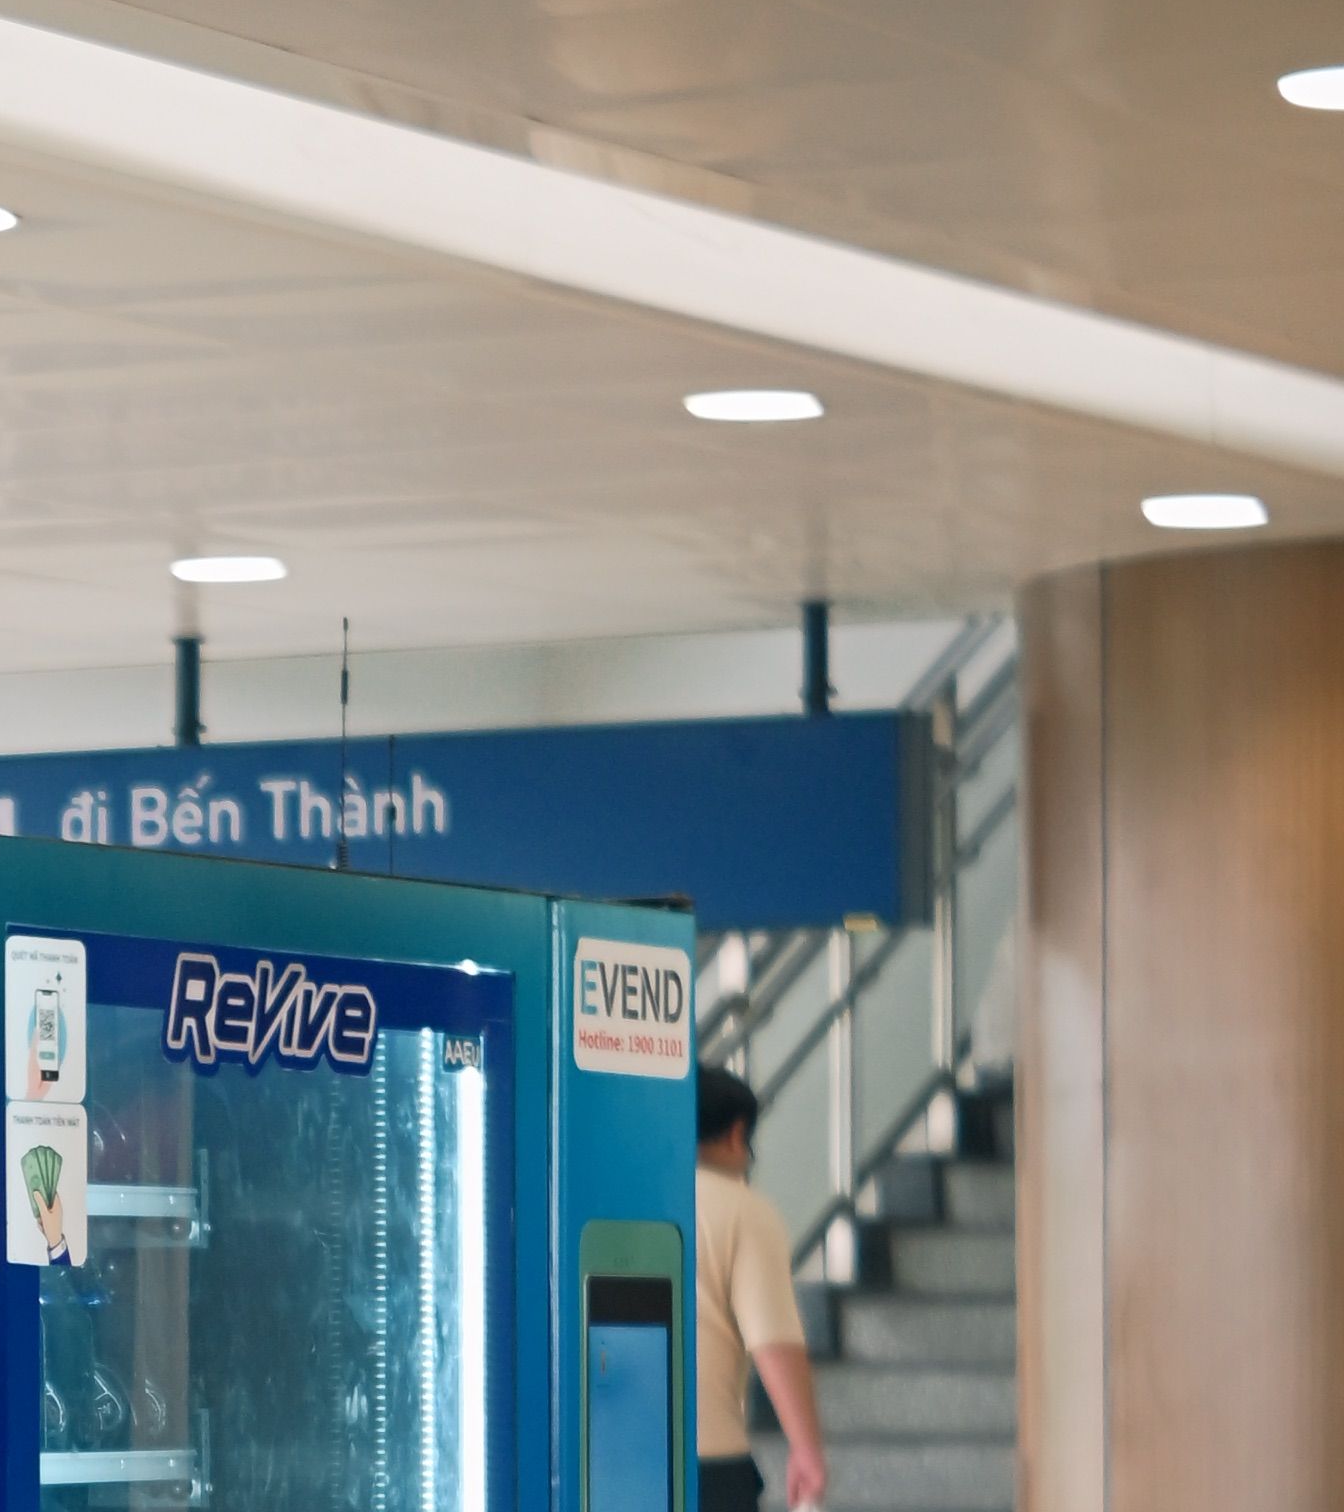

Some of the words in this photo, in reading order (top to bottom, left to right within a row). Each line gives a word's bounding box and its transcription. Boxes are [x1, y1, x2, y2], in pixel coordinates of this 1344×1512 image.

[60, 789, 109, 846] đi
[130, 774, 242, 847] Bến
[258, 770, 448, 840] Thành
[580, 959, 684, 1024] EVEND
[578, 1028, 625, 1052] Hotline:
[628, 1035, 655, 1055] 1900
[657, 1039, 684, 1058] 3101
